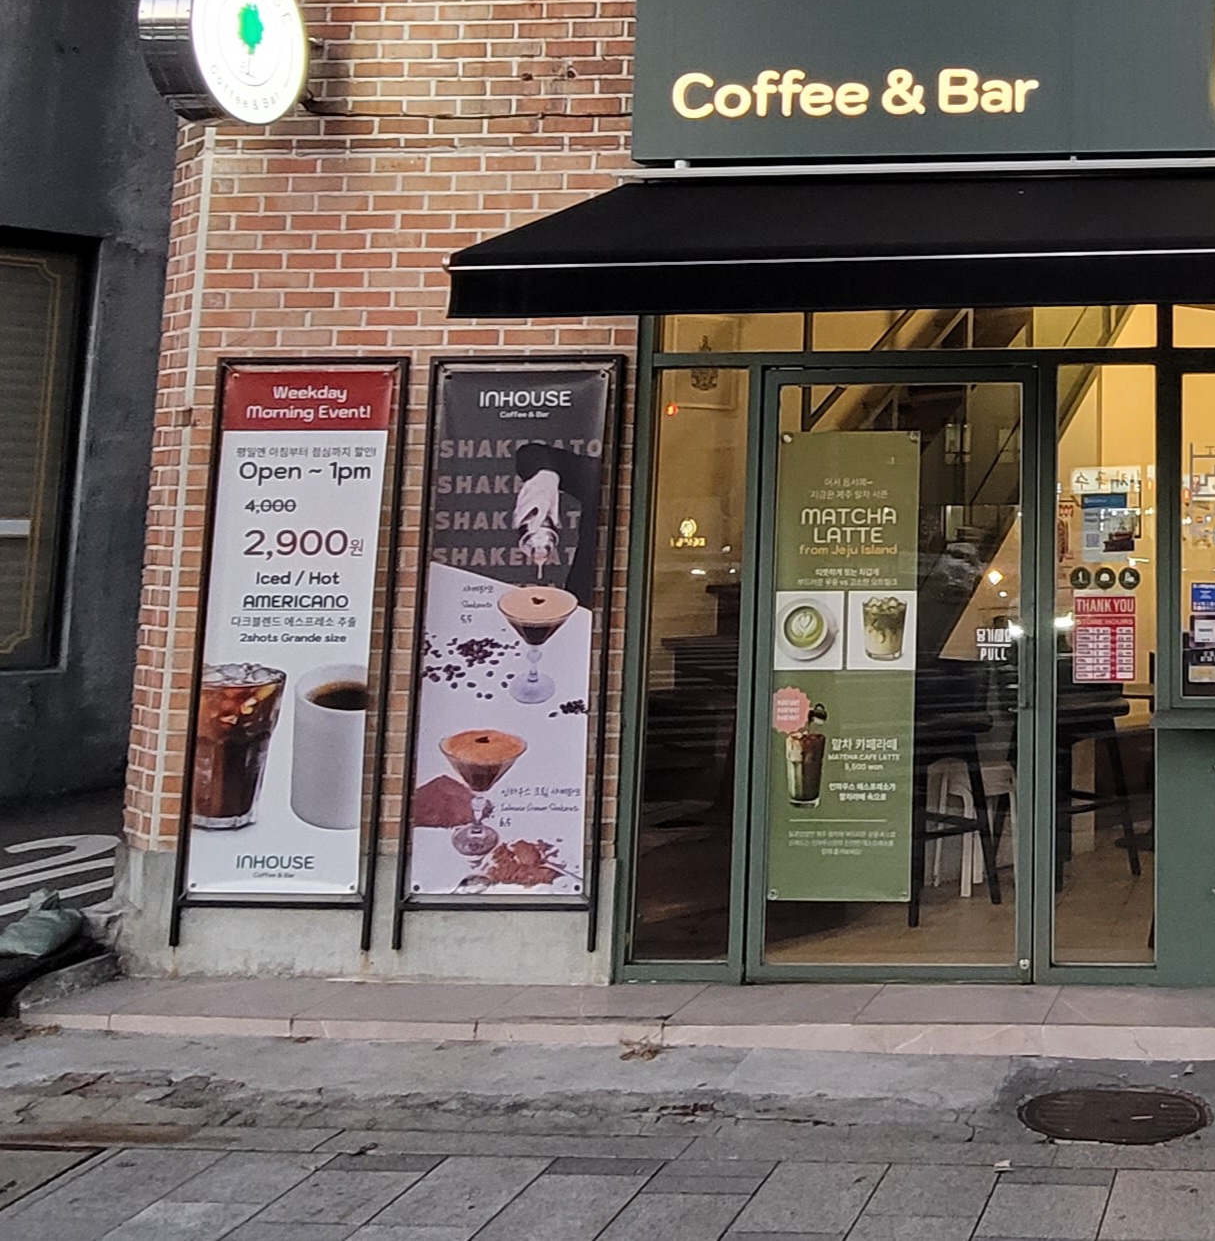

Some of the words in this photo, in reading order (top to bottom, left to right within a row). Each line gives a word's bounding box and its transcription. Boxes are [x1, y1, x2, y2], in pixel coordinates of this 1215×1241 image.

[671, 69, 870, 120] Coffee
[880, 68, 926, 115] &
[936, 68, 1040, 115] Bar
[272, 385, 348, 403] Weekday
[479, 390, 573, 408] INHOUSE
[246, 405, 315, 423] Morning
[317, 405, 372, 419] Event!
[499, 411, 527, 419] Coffee
[239, 461, 302, 486] Open
[328, 461, 372, 486] 1pm
[244, 499, 297, 514] 4,000
[801, 507, 897, 525] MATCHA
[813, 527, 883, 544] LATTE
[243, 529, 365, 560] 2,900원
[799, 545, 829, 555] from
[831, 545, 858, 559] Jeju
[861, 544, 898, 555] Island
[255, 571, 292, 585] Iced
[294, 570, 306, 586] /
[308, 571, 341, 585] Hot
[242, 594, 349, 608] AMERICANO
[1076, 598, 1112, 613] THANK
[1114, 598, 1134, 613] YOU
[239, 633, 279, 643] 2shots
[280, 633, 323, 643] Grande
[324, 633, 347, 643] size
[980, 647, 1008, 661] PULL
[236, 854, 315, 870] INHOUSE
